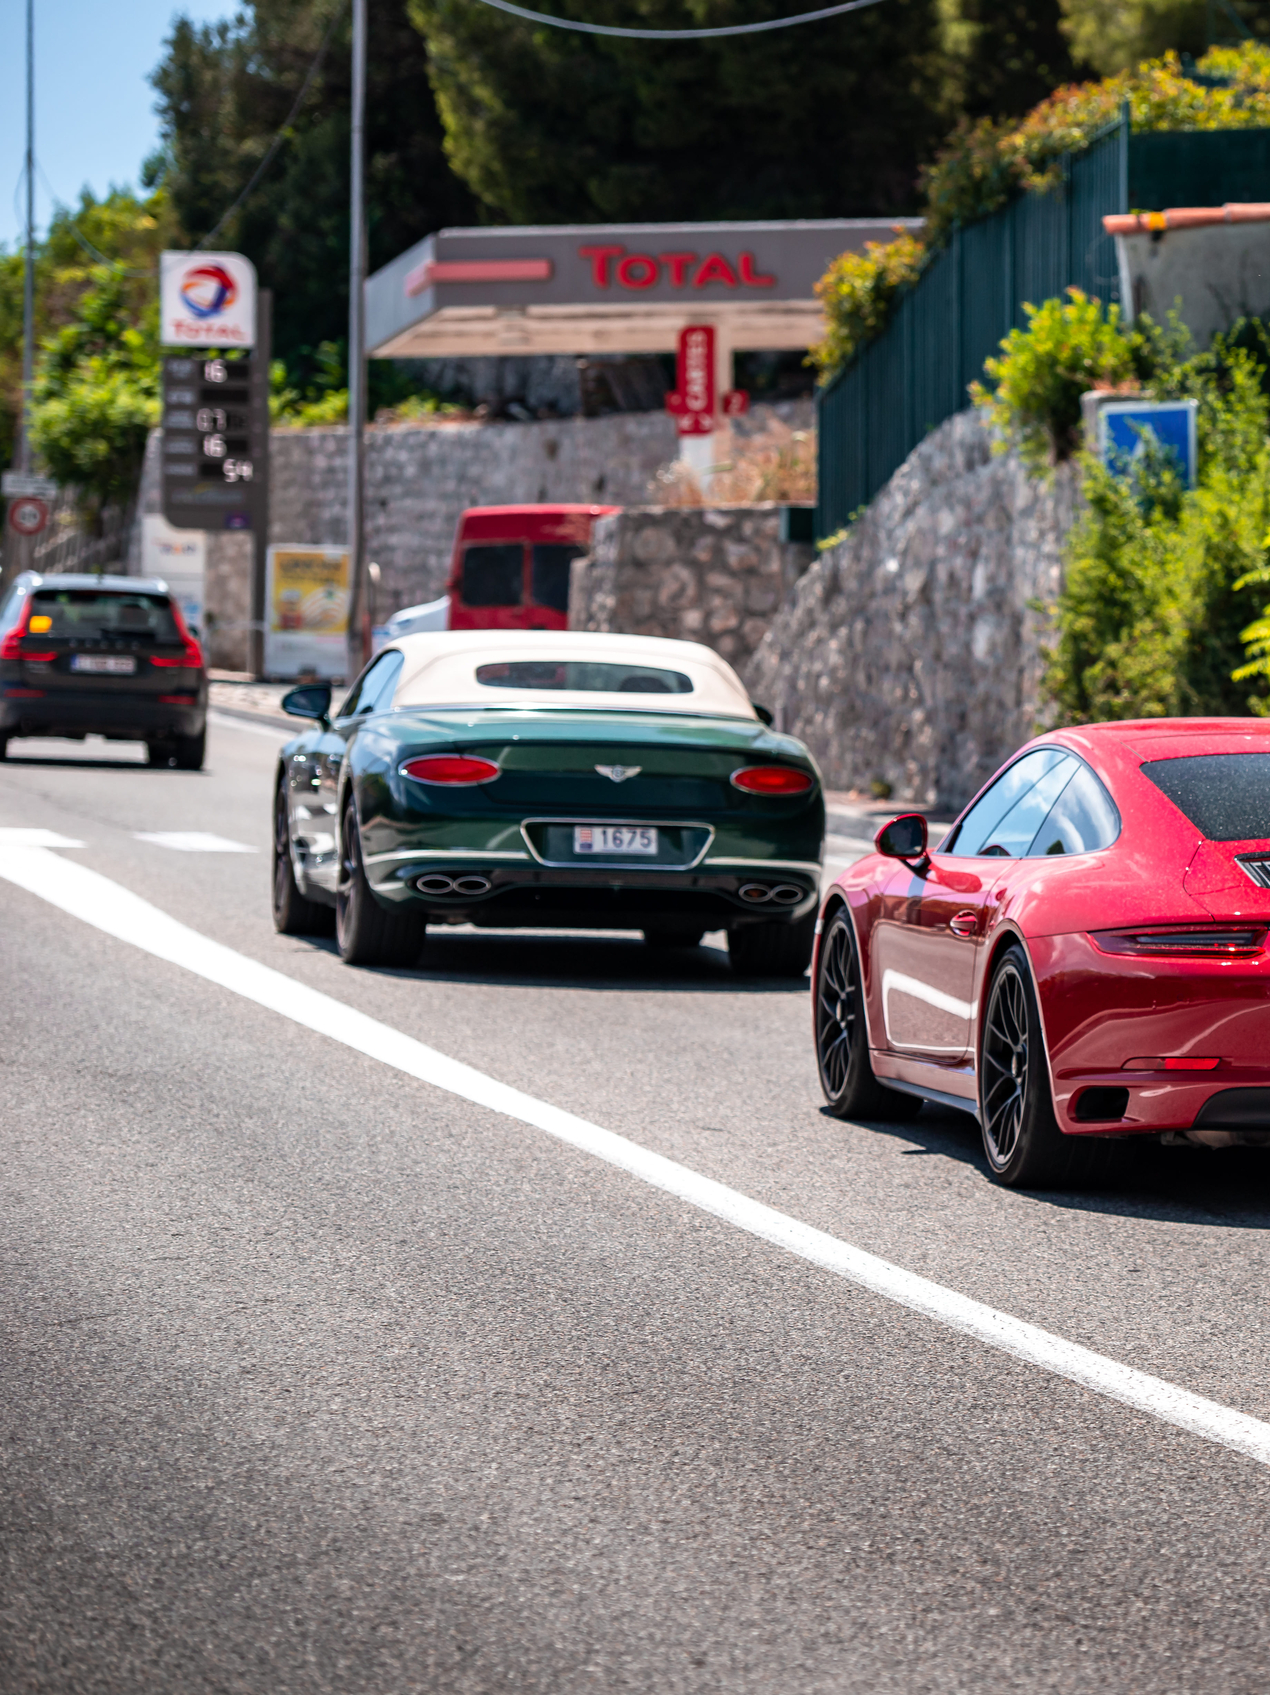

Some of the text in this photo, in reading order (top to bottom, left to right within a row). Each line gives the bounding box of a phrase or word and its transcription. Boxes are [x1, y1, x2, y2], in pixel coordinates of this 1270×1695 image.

[579, 244, 777, 291] TOTAL
[171, 318, 247, 341] TOTAL
[602, 829, 652, 848] 1675
